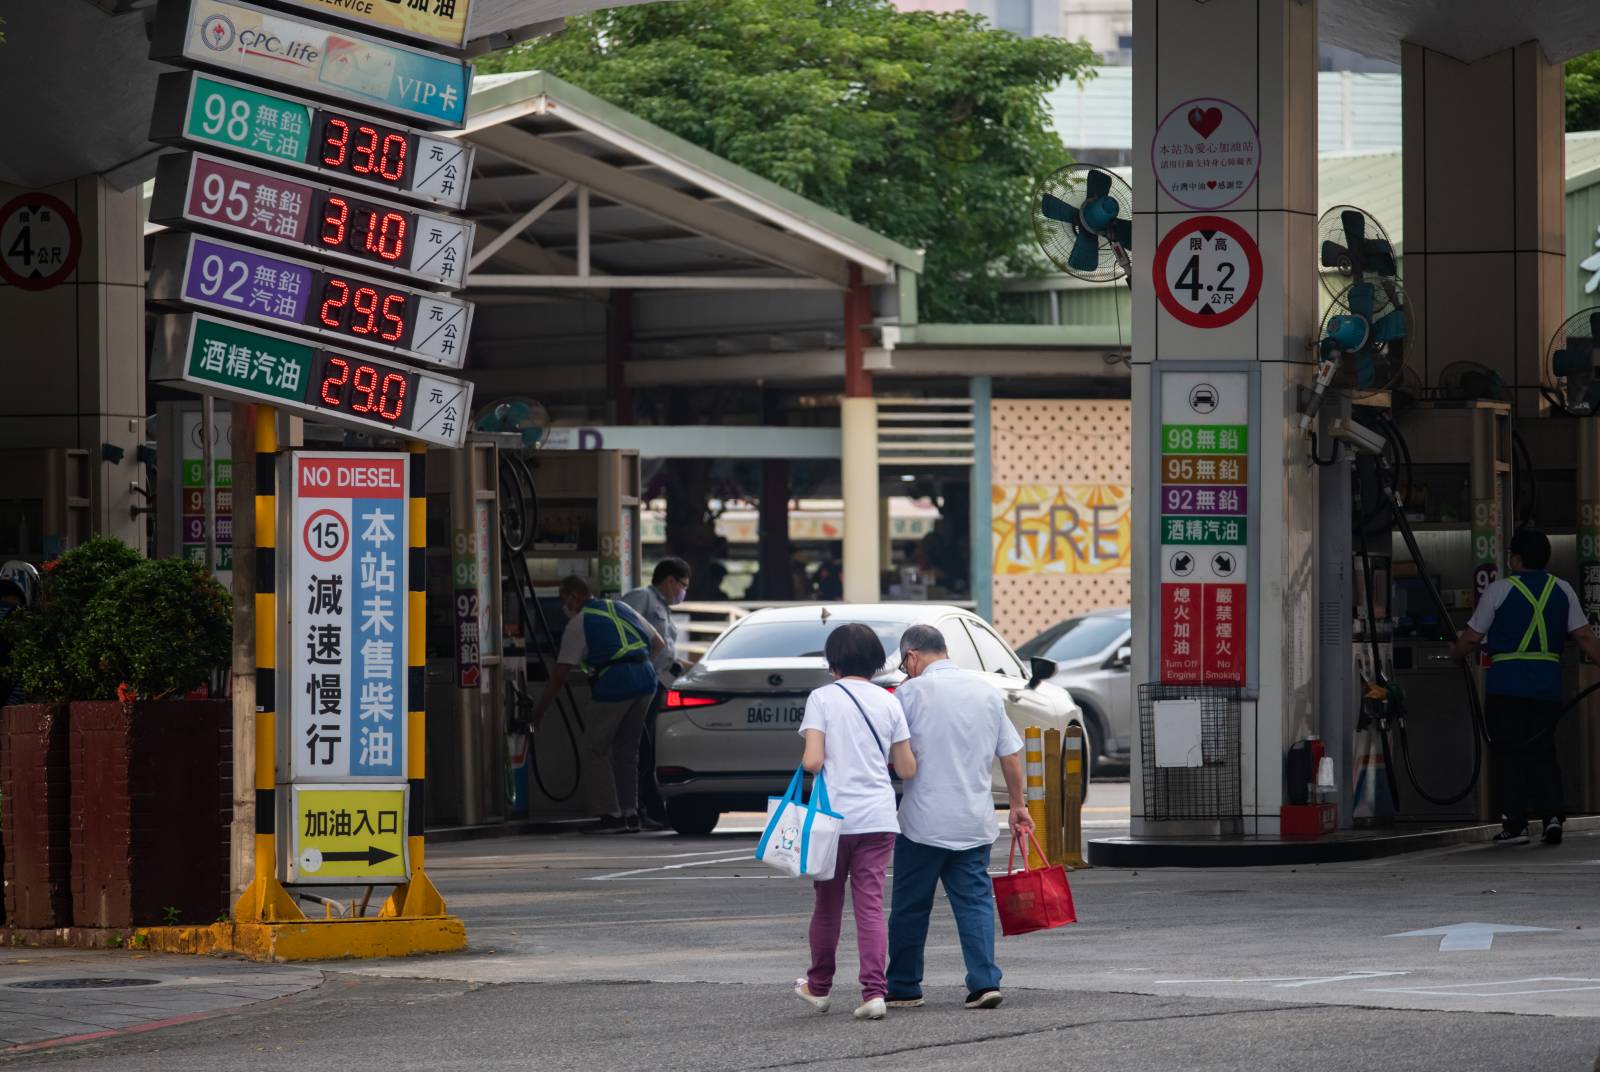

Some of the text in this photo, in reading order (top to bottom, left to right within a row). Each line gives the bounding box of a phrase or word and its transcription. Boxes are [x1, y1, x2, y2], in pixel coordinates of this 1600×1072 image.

[319, 0, 374, 14] RVICE
[202, 94, 250, 141] 98
[255, 105, 304, 132] 無鉛
[252, 128, 299, 158] 汽油
[323, 119, 407, 181] 33.0
[200, 173, 250, 222] 95
[254, 184, 303, 215] 無鉛
[251, 208, 298, 238] 汽油
[323, 197, 407, 260] 31.0
[8, 226, 34, 266] 4
[38, 247, 62, 264] 公尺
[200, 253, 250, 303] 92
[253, 264, 302, 294] 無鉛
[1174, 254, 1236, 301] 4.2
[250, 288, 297, 318] 汽油
[321, 279, 407, 342] 29.5
[1211, 293, 1235, 304] 公尺
[200, 338, 302, 392] 酒精汽油
[321, 357, 407, 420] 29.0
[303, 466, 401, 487] NO DIESEL
[312, 522, 339, 548] 15
[1167, 519, 1239, 541] 酒精汽油
[456, 563, 479, 585] 98
[457, 595, 479, 617] 92
[1173, 587, 1191, 656] 熄火加油
[1215, 587, 1233, 656] 嚴禁煙火
[359, 508, 395, 766] 本站未售柴油
[460, 622, 479, 664] 無鉛
[306, 574, 343, 765] 減速慢行
[1165, 660, 1198, 668] Turn Off
[1167, 670, 1197, 680] Engine
[1205, 670, 1241, 681] Smoking
[1217, 660, 1231, 668] No
[304, 809, 398, 837] 加油入口
